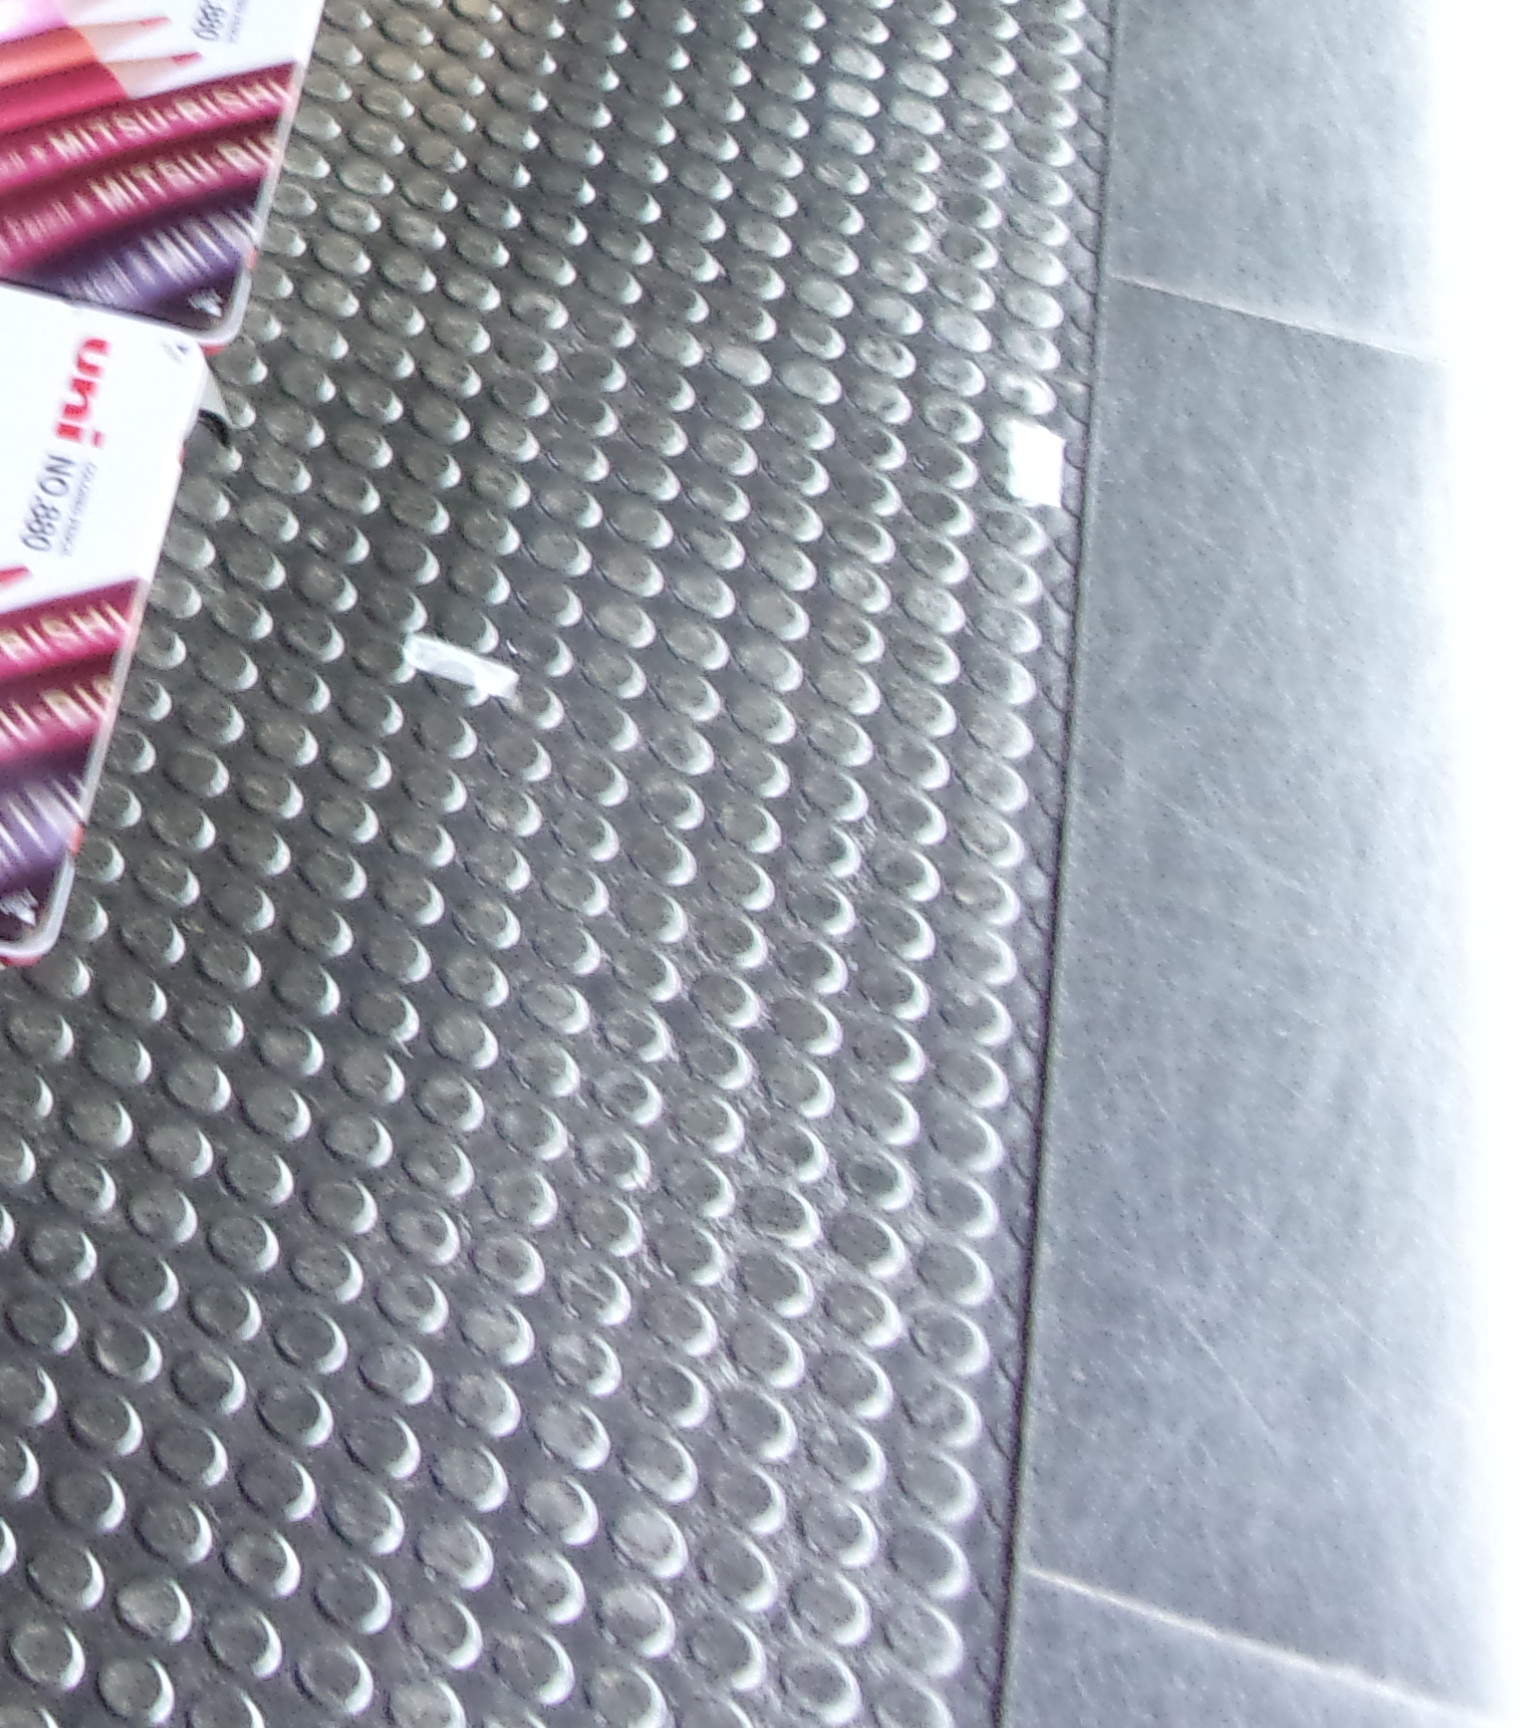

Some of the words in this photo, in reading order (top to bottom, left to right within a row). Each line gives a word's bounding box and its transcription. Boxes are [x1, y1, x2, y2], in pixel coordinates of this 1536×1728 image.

[46, 77, 290, 161] MITSU-BISHI
[55, 337, 112, 449] uni
[19, 454, 73, 553] NO.880
